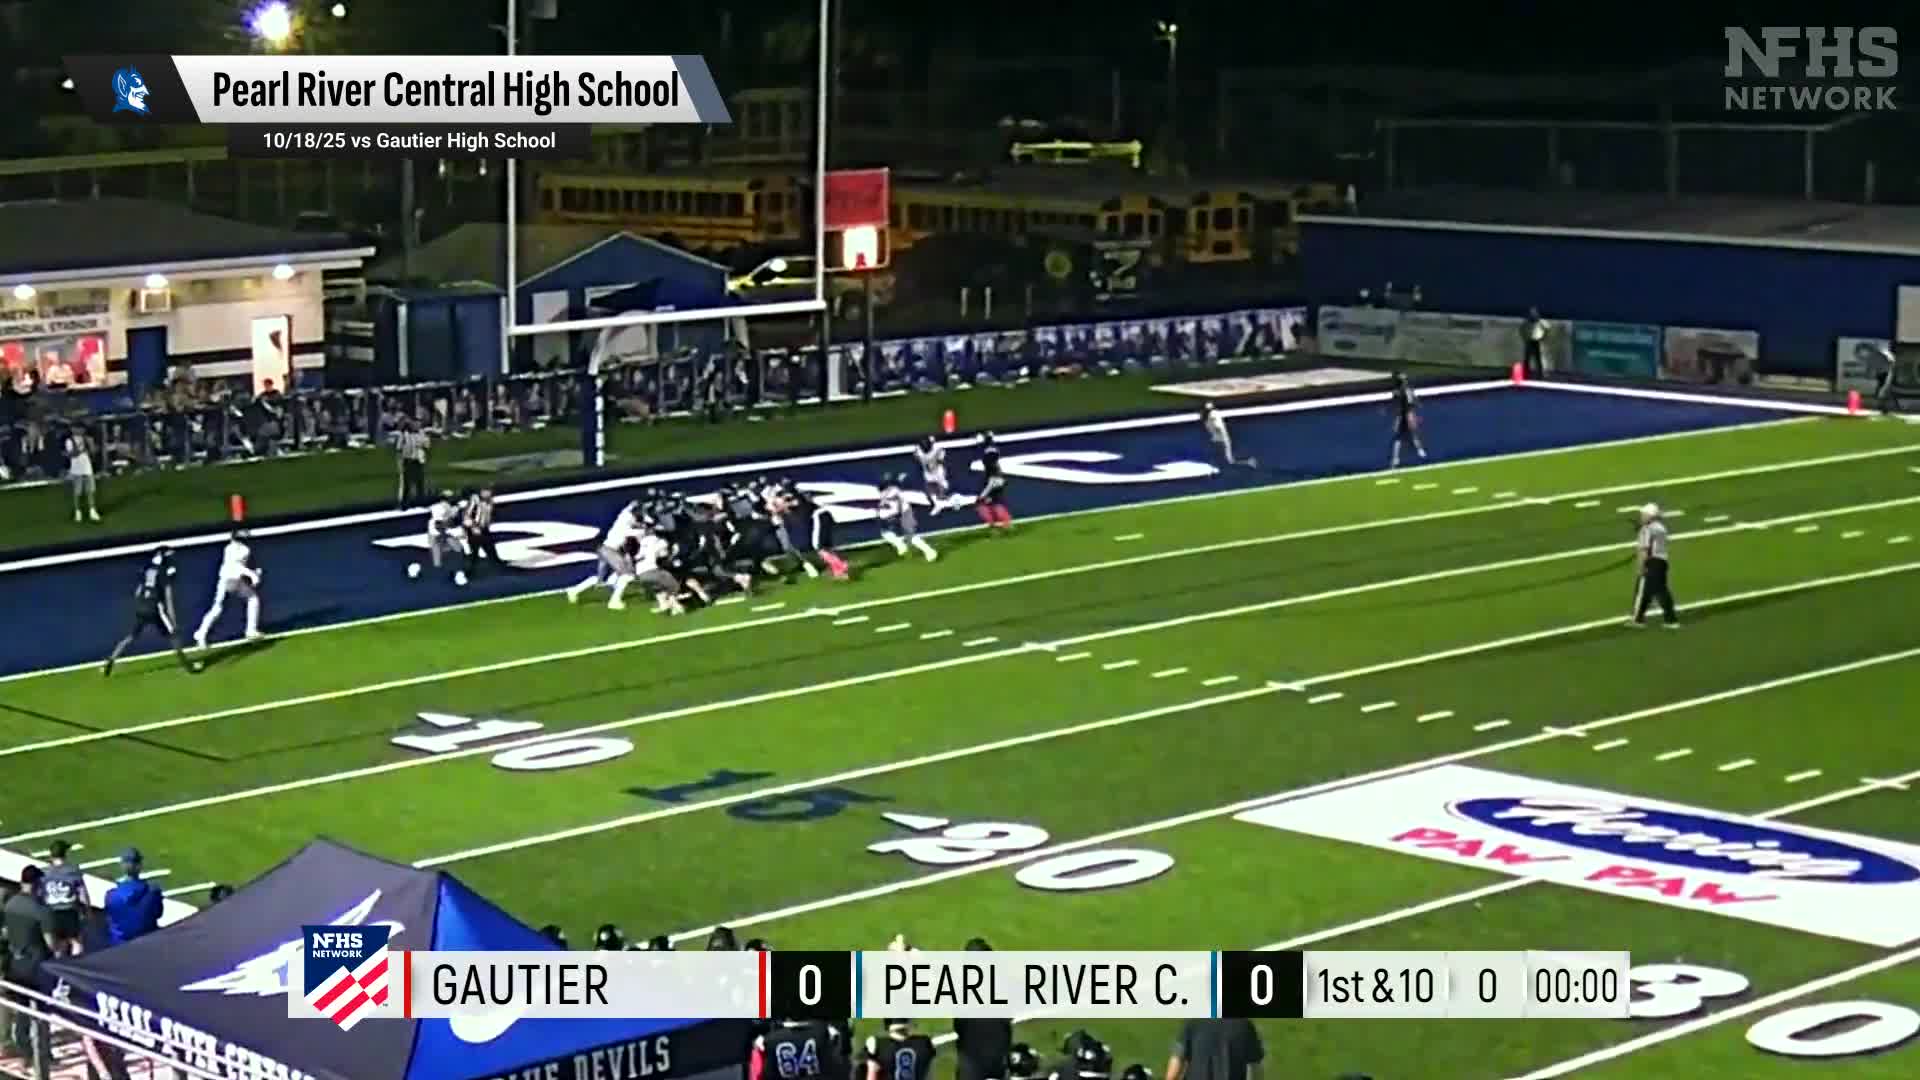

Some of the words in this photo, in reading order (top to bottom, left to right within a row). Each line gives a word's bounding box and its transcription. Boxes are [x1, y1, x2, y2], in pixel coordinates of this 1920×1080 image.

[1390, 827, 1571, 864] PAW
[1584, 865, 1779, 905] PAW
[573, 1035, 671, 1080] DEVILS
[775, 1037, 821, 1079] 64
